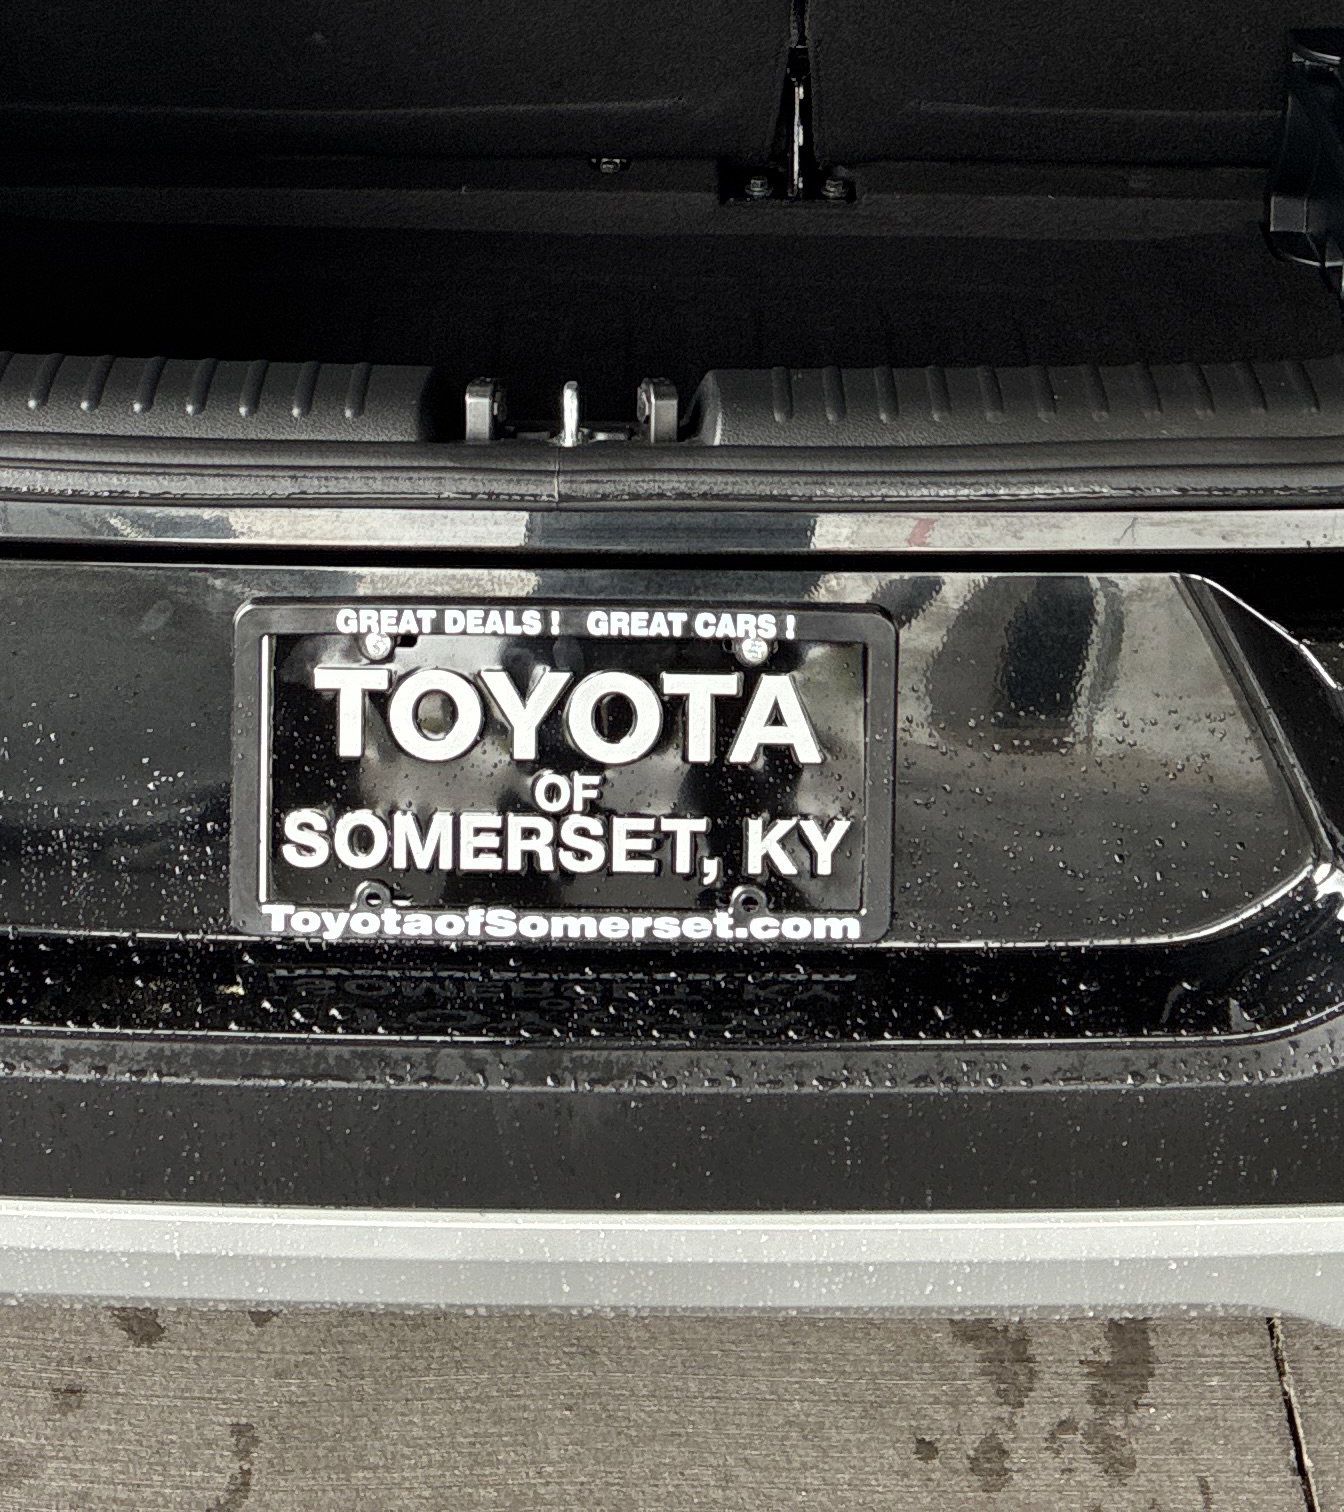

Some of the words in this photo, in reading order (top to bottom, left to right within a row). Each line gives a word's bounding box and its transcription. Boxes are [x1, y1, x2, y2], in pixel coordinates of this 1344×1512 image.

[335, 608, 436, 635] GREAT
[444, 609, 542, 636] DEALS
[586, 610, 688, 637] GREAT
[694, 612, 777, 639] CARS
[313, 665, 823, 765] TOYOTA
[533, 769, 602, 813] OF
[281, 807, 719, 886] SOMERSET,
[746, 815, 852, 876] KY
[260, 903, 862, 941] ToyotaofSomerset.com
